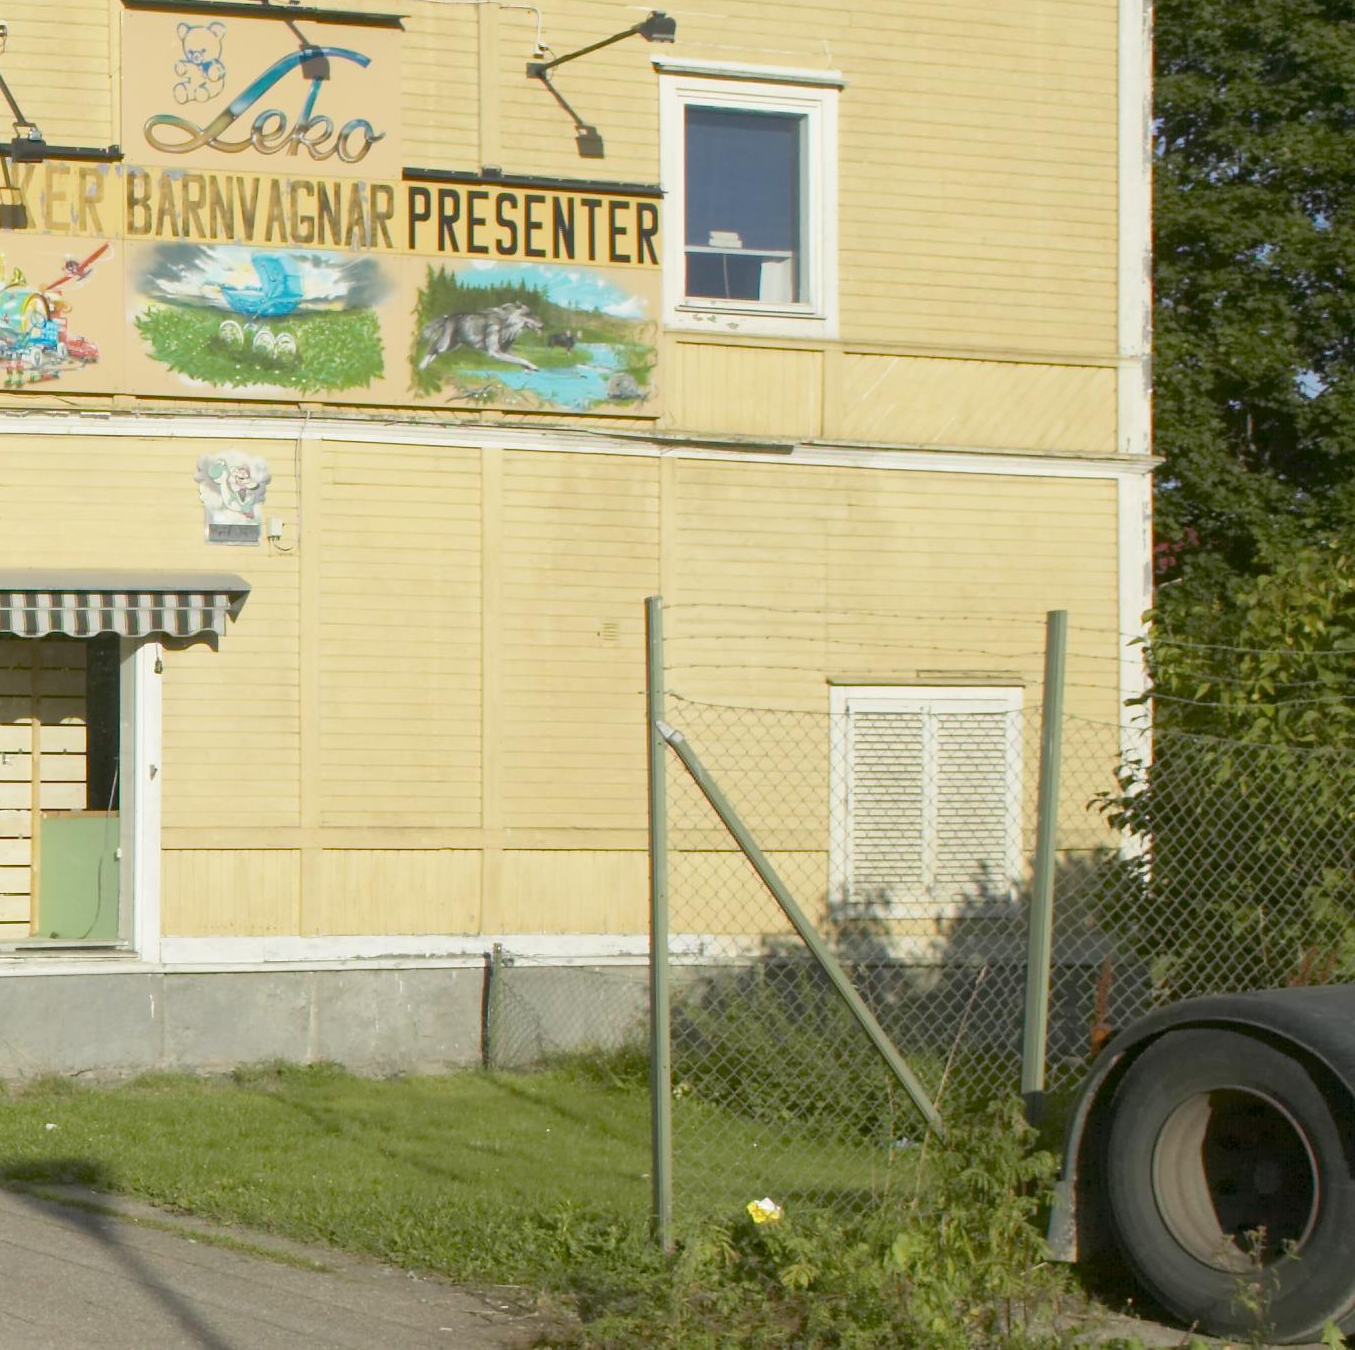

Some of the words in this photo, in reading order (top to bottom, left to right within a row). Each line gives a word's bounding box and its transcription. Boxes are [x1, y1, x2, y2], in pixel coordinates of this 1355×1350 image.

[143, 46, 387, 164] Leko
[126, 171, 395, 249] BARNVAGNAR
[408, 185, 659, 265] PRESENTER
